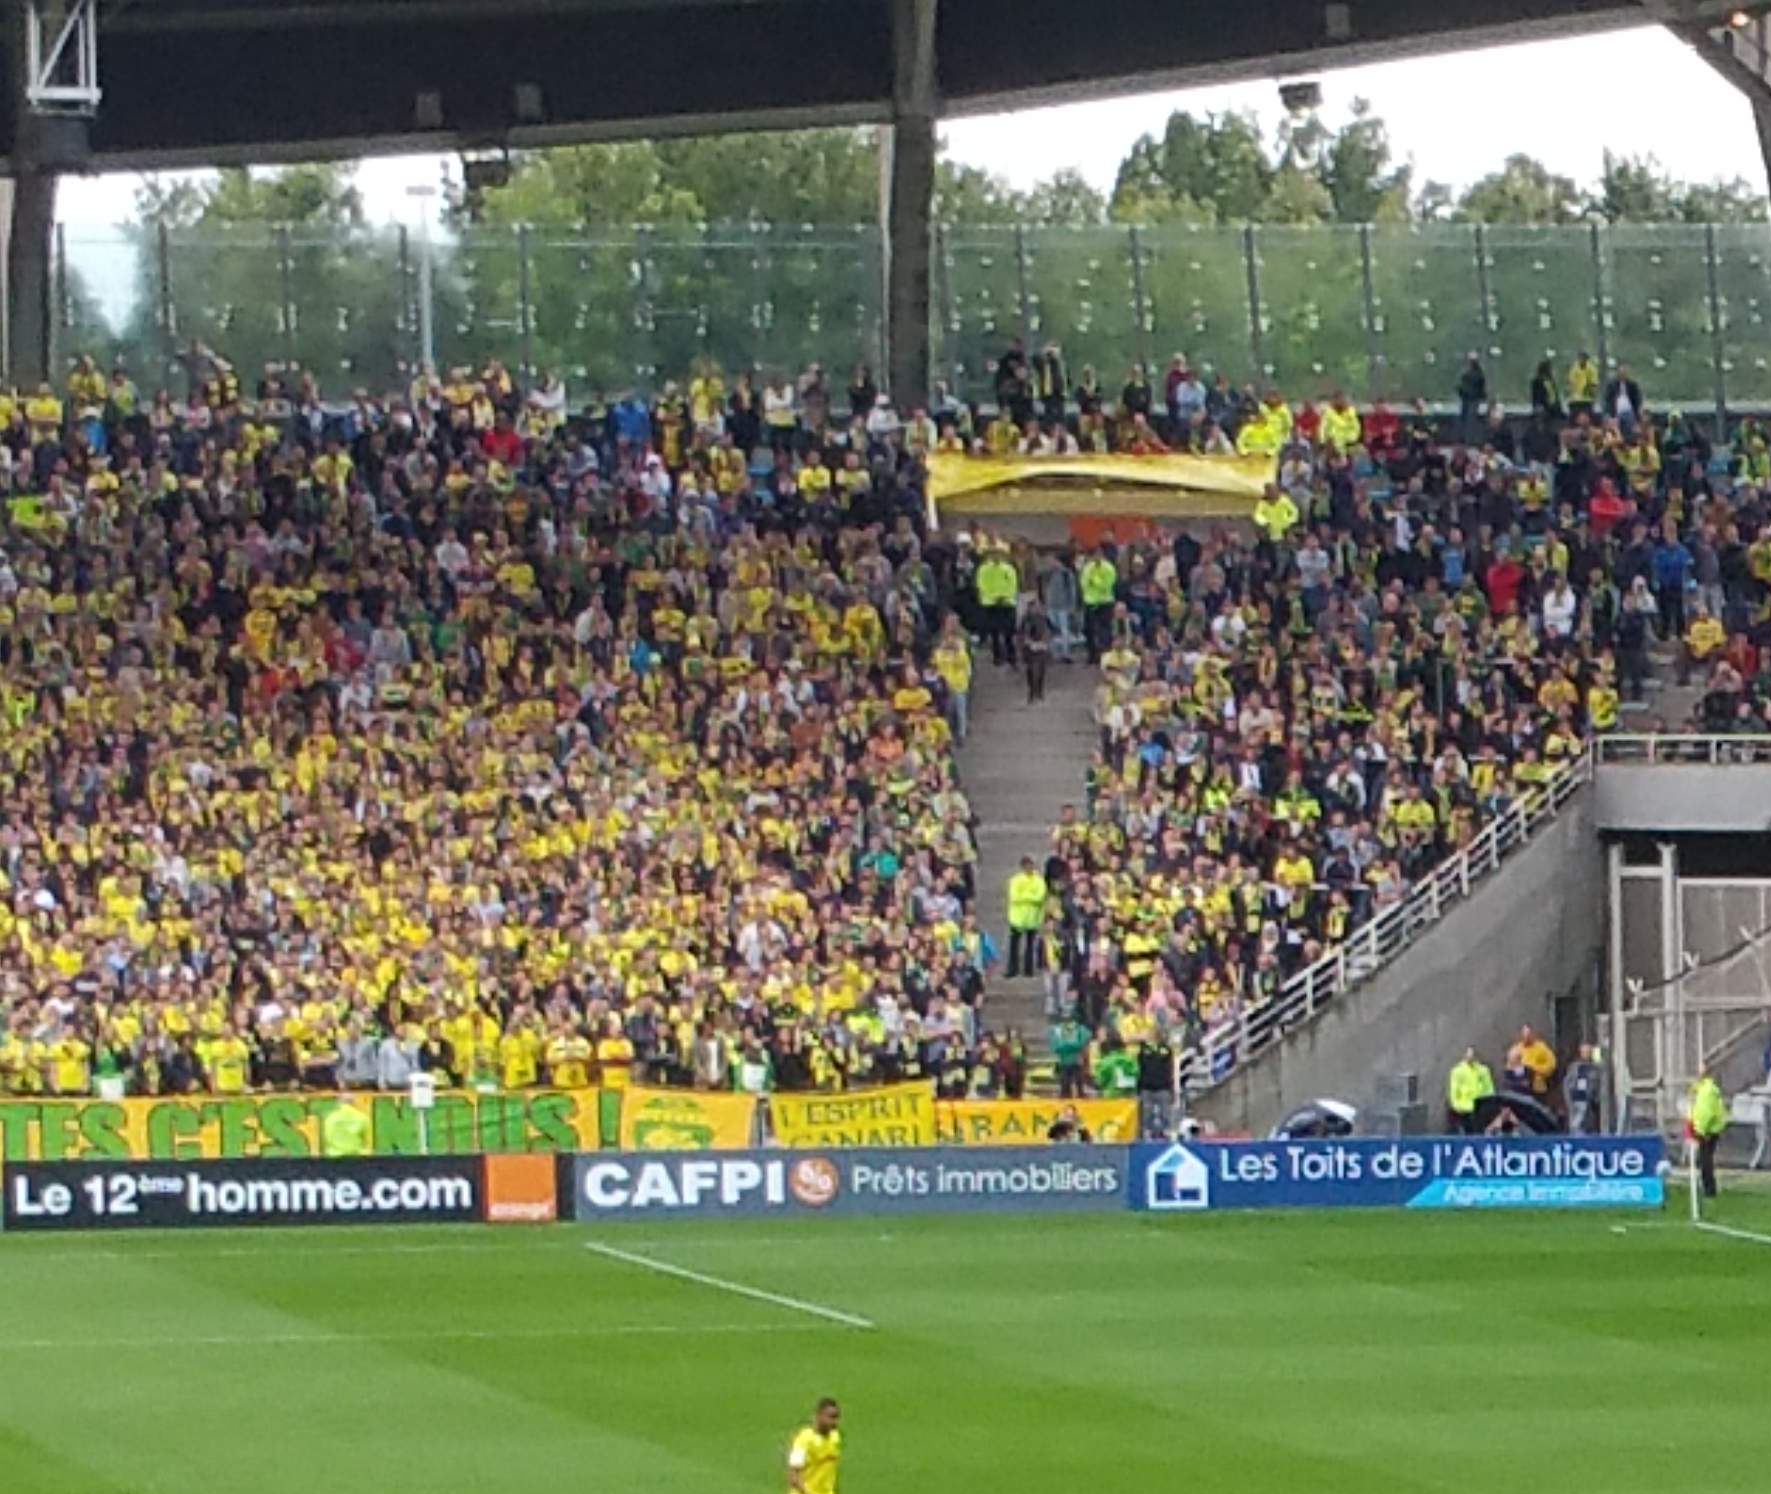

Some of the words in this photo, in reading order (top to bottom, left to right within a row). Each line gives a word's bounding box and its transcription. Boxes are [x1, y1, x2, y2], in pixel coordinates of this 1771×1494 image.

[584, 1160, 784, 1208] CAFPI
[852, 1162, 929, 1196] Prêts
[937, 1160, 1117, 1193] immobiliers
[1220, 1148, 1278, 1182] Les
[1286, 1146, 1362, 1181] Toits
[1370, 1146, 1423, 1179] de
[1433, 1144, 1645, 1185] l'Atlantique
[15, 1174, 72, 1216] Le
